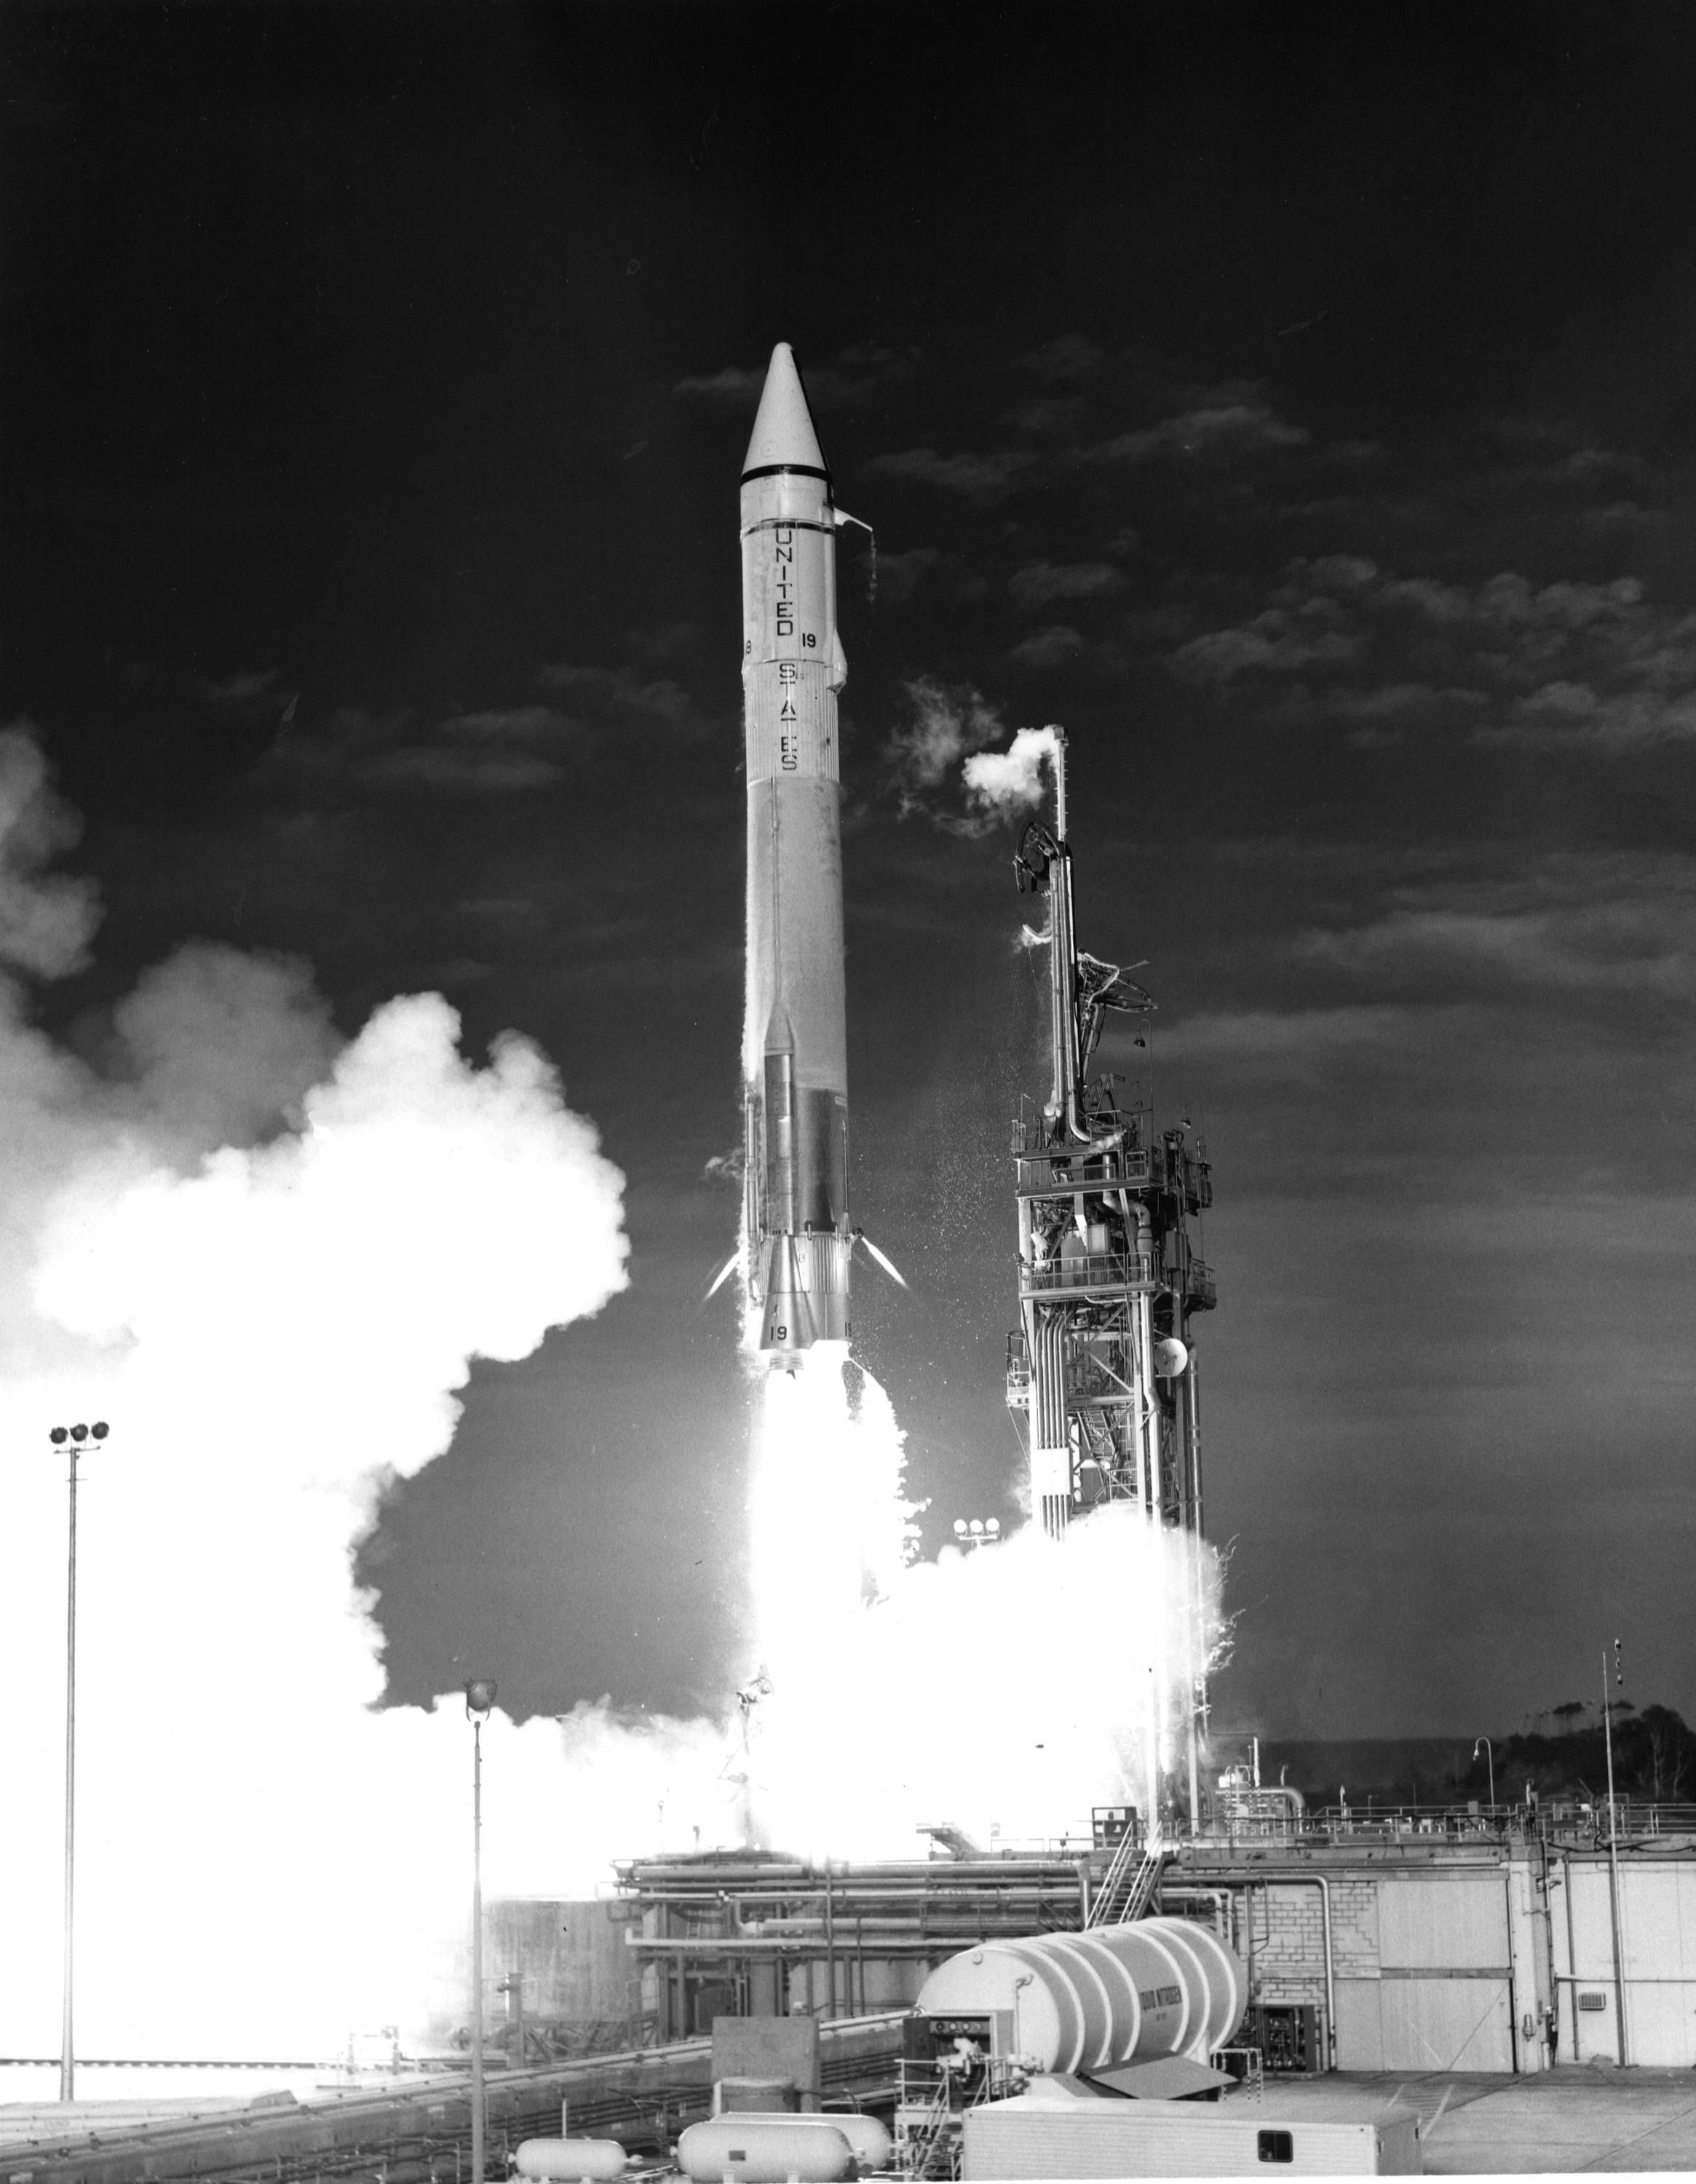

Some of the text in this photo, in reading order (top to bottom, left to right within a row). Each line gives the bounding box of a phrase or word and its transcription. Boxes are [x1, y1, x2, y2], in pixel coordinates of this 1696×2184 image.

[802, 633, 816, 647] 19
[775, 529, 797, 770] UNITED STATES
[770, 1326, 787, 1341] 19
